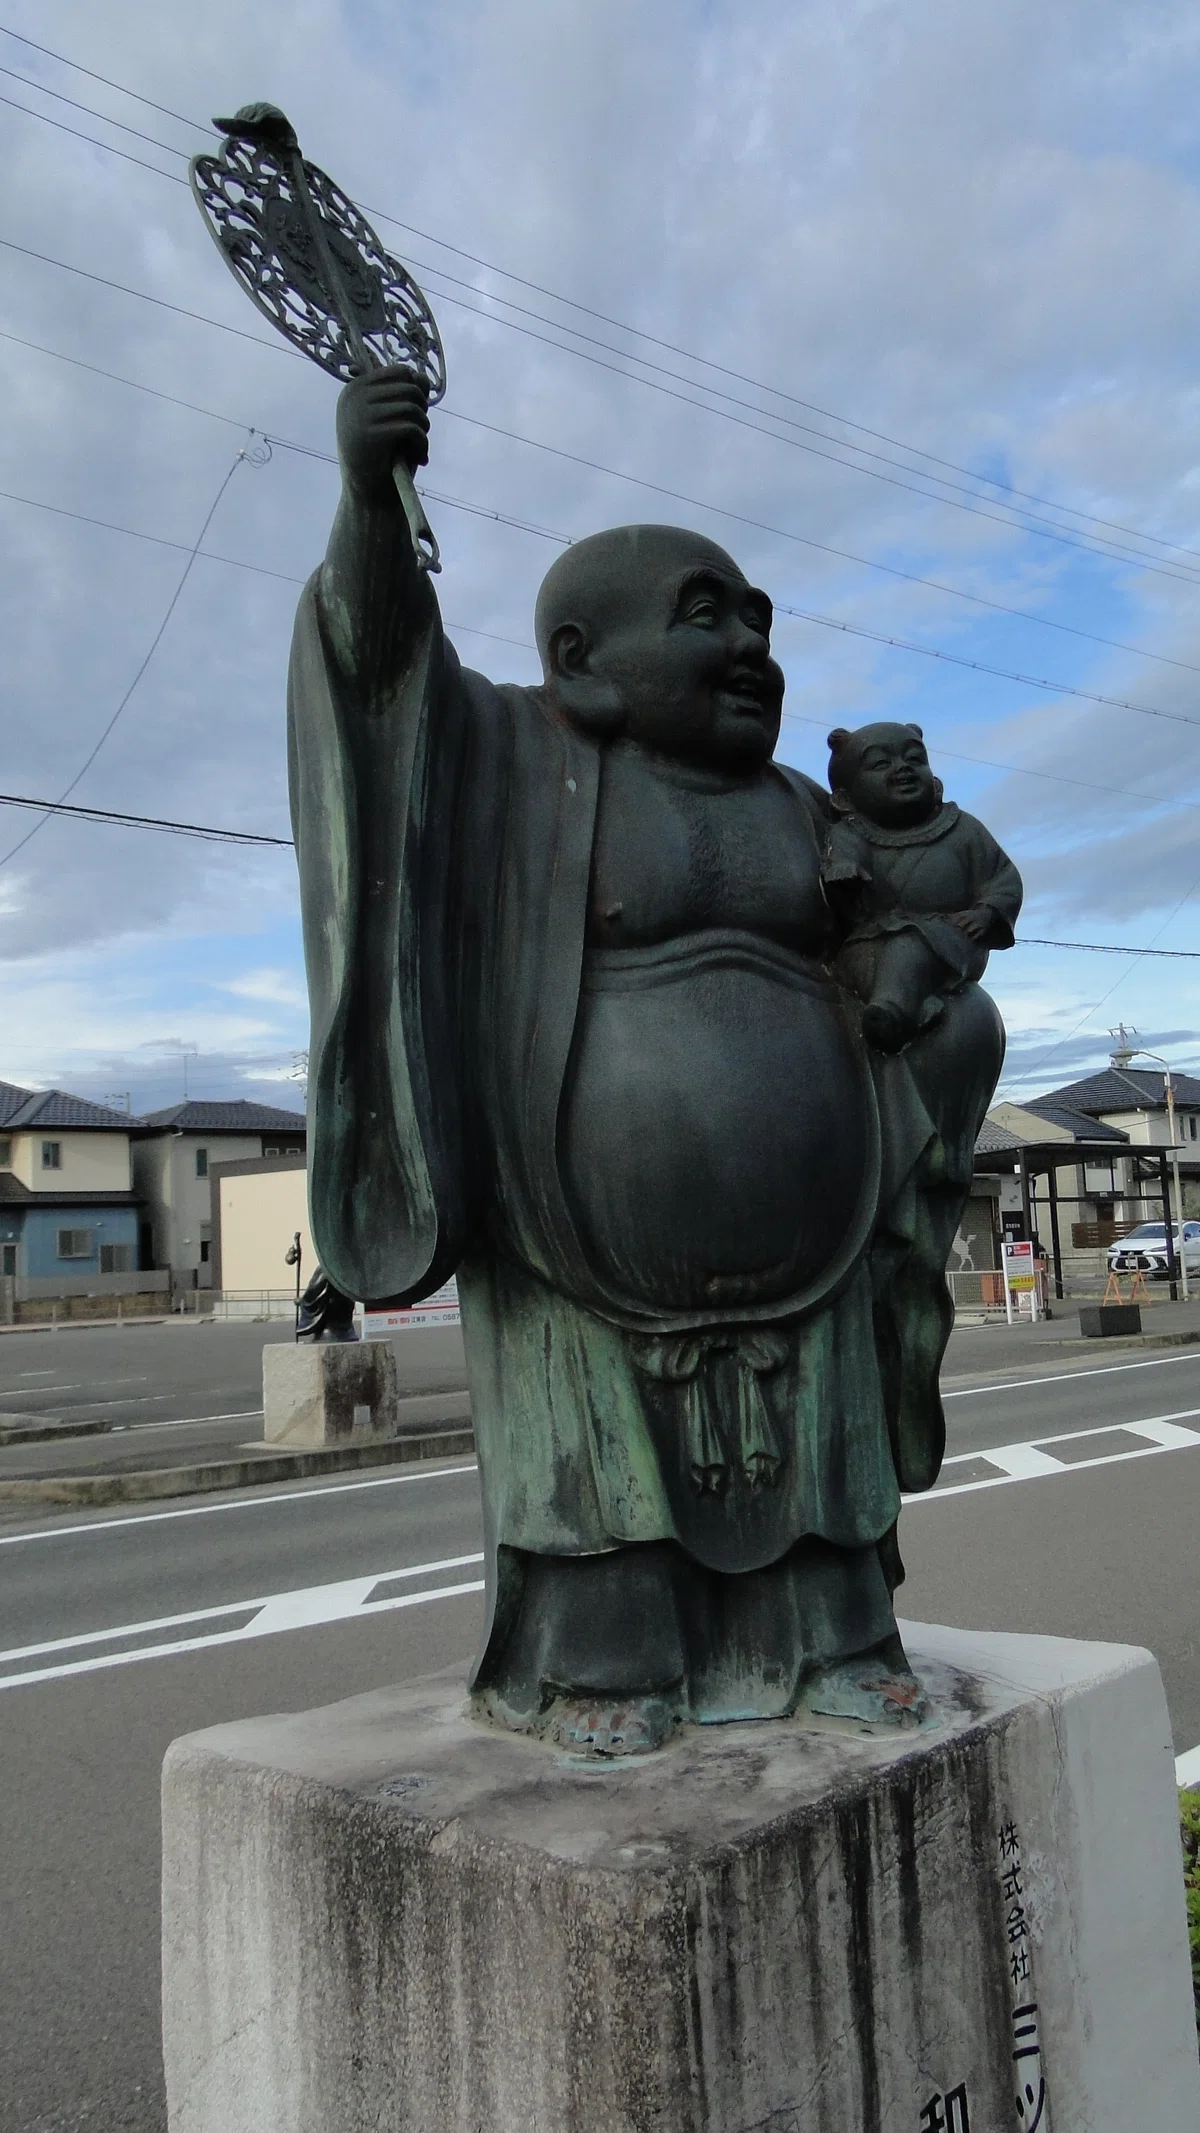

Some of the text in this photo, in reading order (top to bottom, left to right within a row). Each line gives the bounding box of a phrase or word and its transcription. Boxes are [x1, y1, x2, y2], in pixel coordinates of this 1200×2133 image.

[1007, 1246, 1012, 1255] P
[999, 1821, 1030, 1985] 株式会社
